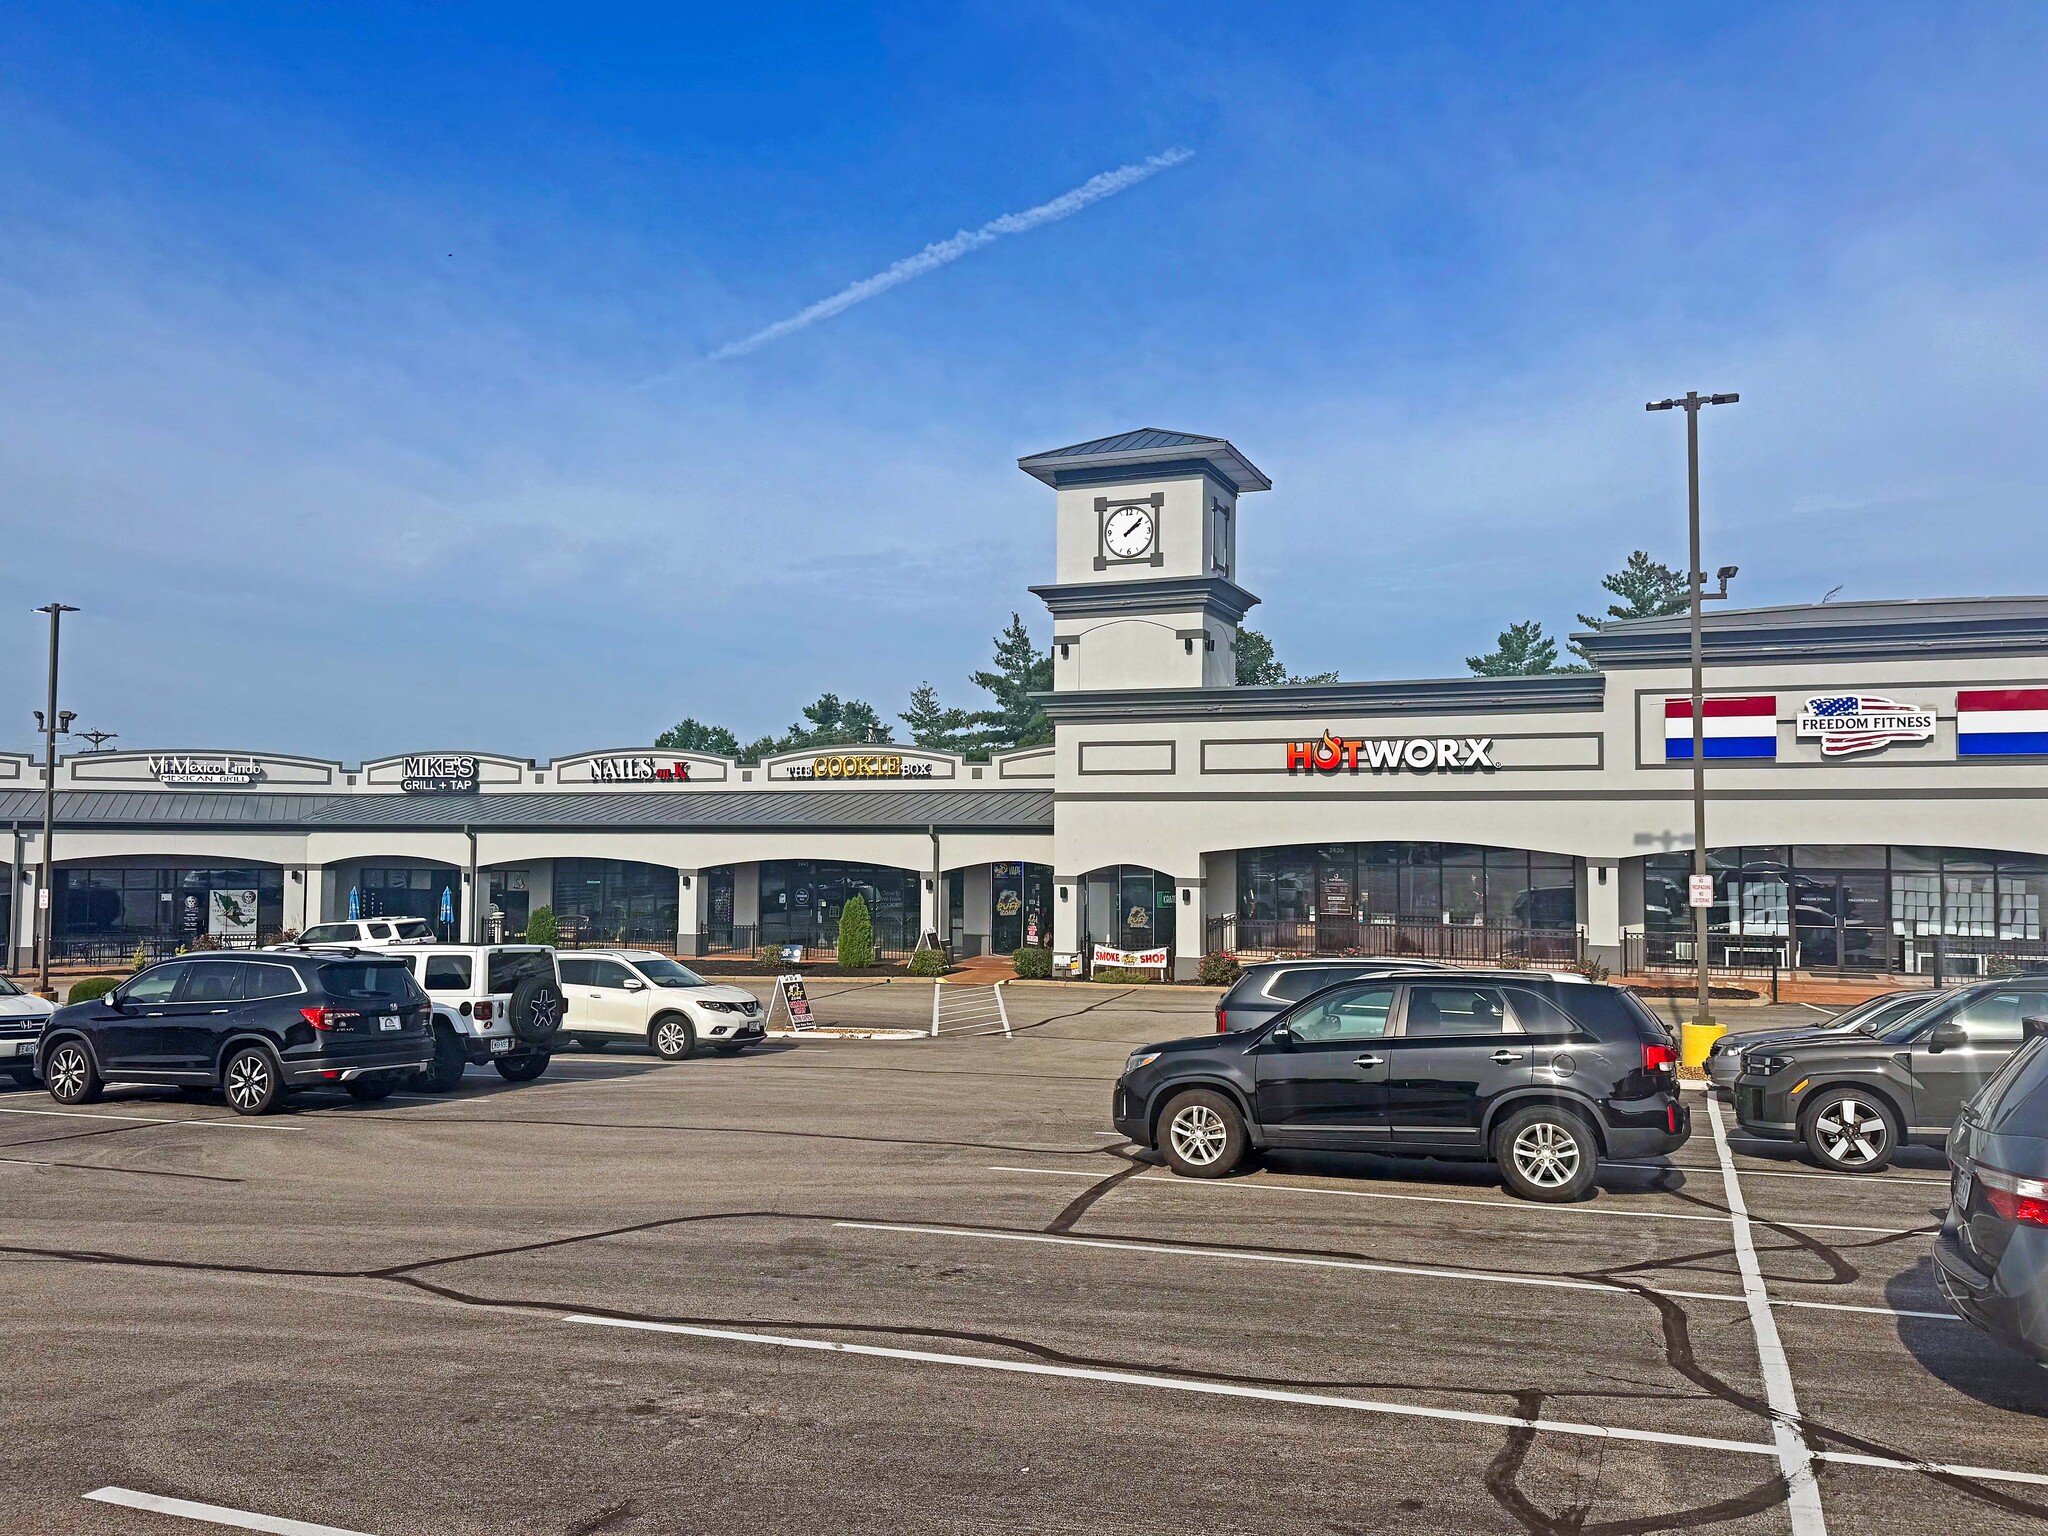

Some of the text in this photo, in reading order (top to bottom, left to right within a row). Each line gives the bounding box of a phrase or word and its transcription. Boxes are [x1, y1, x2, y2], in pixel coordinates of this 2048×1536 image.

[1802, 715, 1932, 731] FREEDOM FITNESS
[1287, 729, 1494, 770] HOTWORX
[148, 756, 261, 775] Mi Mexico Lindo
[403, 757, 474, 778] MIKE'S
[588, 758, 654, 780] NAILS
[673, 761, 688, 779] K
[787, 756, 930, 778] THE COOKIE BOX
[161, 775, 248, 783] MEXICAN GRILL
[404, 781, 436, 790] GRILL
[450, 781, 472, 790] TAP
[1009, 865, 1021, 876] VAPE
[997, 901, 1021, 911] PUFF
[1095, 950, 1166, 964] SMOKE SHOP
